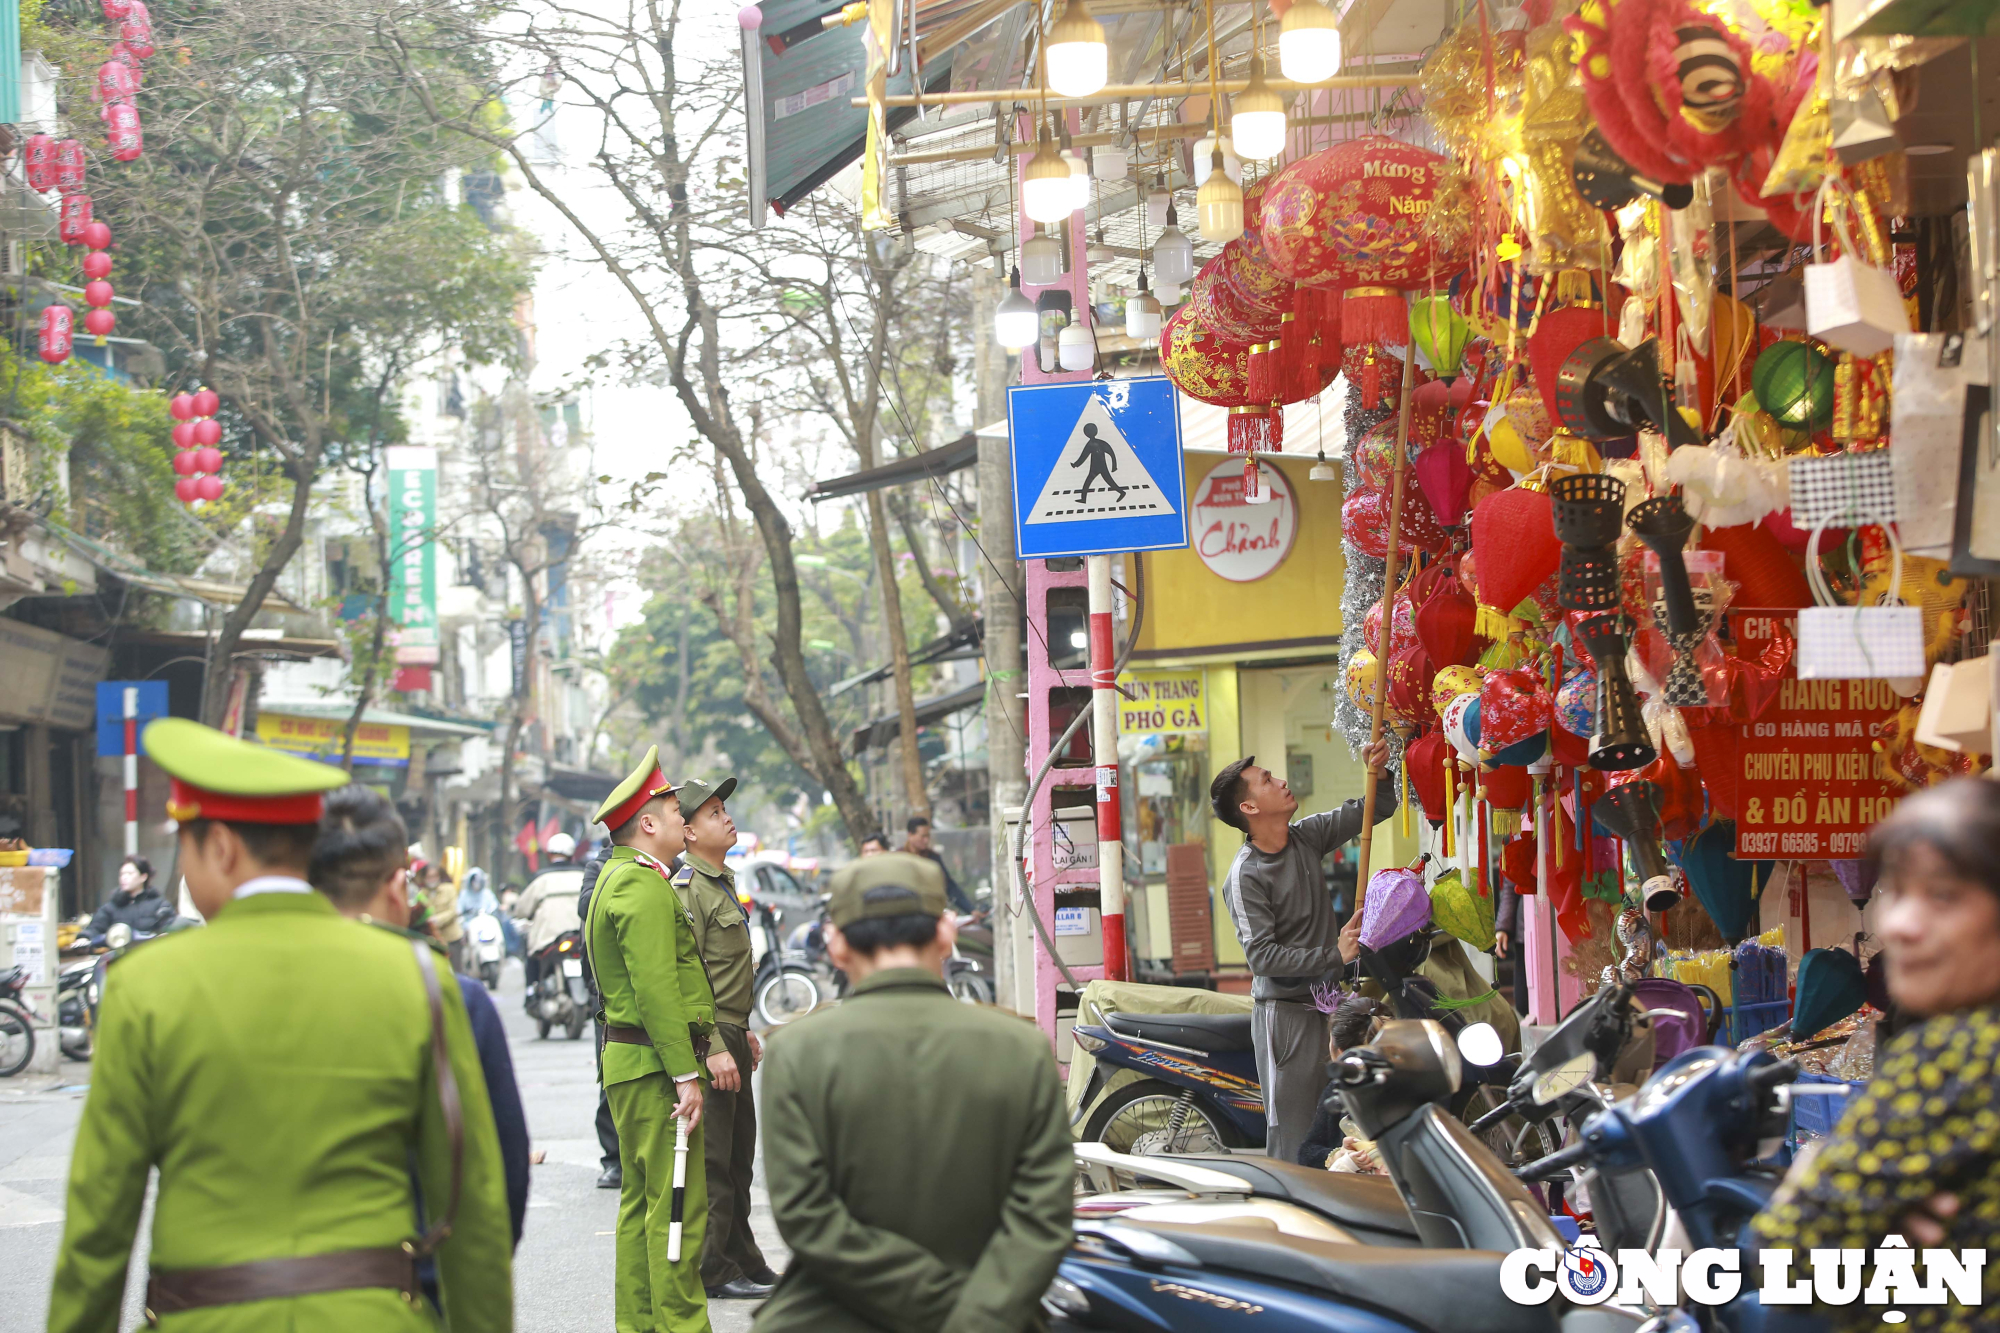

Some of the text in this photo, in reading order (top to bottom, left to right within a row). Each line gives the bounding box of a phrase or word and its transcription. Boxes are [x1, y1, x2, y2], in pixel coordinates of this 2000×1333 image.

[402, 470, 425, 624] ECOGREEN
[1154, 680, 1199, 699] THANG
[1754, 722, 1776, 737] 60
[1781, 720, 1830, 737] HÀNG
[1834, 720, 1864, 737] MÃ
[1744, 748, 1799, 780] CHUYÊN
[1803, 753, 1832, 786] PHỤ
[1836, 748, 1869, 786] KIỆN
[1745, 797, 1764, 824] &
[1773, 788, 1807, 824] ĐỒ
[1815, 792, 1850, 824] ĂN
[1741, 832, 1778, 853] 03937
[1781, 832, 1818, 853] 66585
